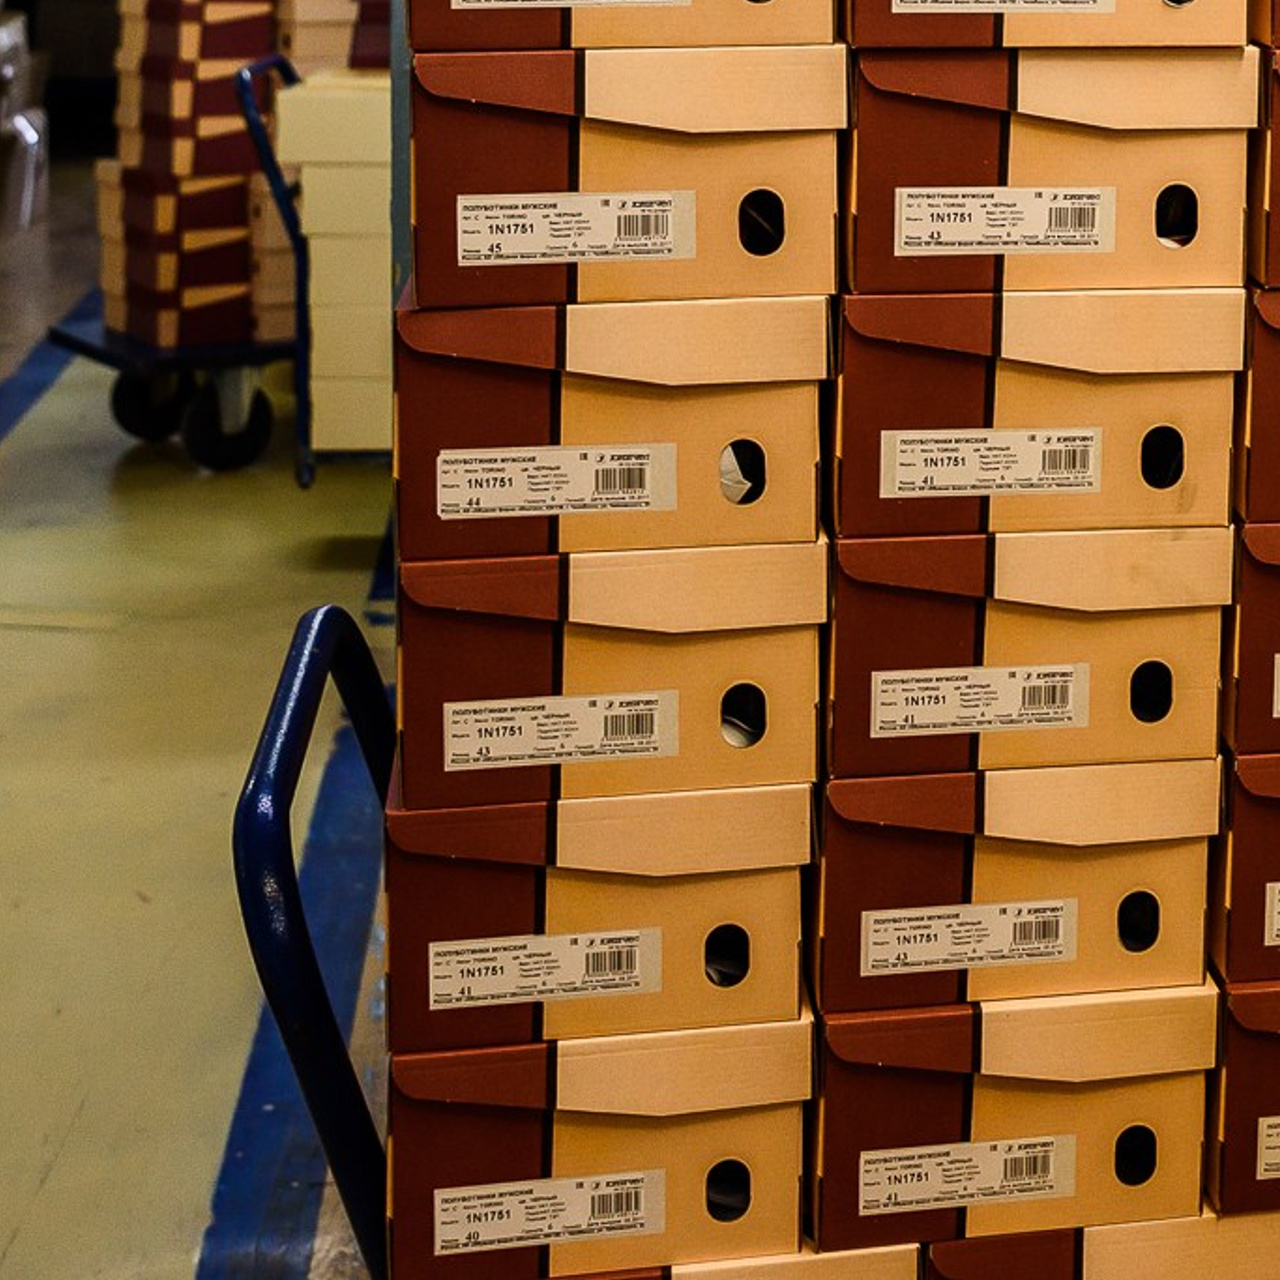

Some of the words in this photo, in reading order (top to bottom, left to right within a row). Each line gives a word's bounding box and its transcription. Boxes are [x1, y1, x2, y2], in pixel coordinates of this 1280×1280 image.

[929, 211, 972, 222] 1N1751
[488, 222, 534, 235] 1N1751
[928, 230, 941, 240] 43
[487, 242, 501, 253] 45
[922, 456, 965, 467] 1N1751
[467, 476, 513, 489] 1N1751
[921, 475, 935, 485] 41
[466, 496, 480, 507] 44
[903, 694, 946, 706] 1N1751
[902, 713, 915, 724] 41
[477, 725, 522, 738] 1N1751
[476, 745, 490, 757] 43
[895, 932, 938, 945] 1N1751
[894, 952, 907, 962] 43
[459, 964, 504, 979] 1N1751
[458, 985, 472, 996] 41
[886, 1171, 929, 1185] 1N1751
[886, 1191, 899, 1202] 41
[465, 1209, 511, 1224] 1N1751
[465, 1230, 479, 1242] 40
